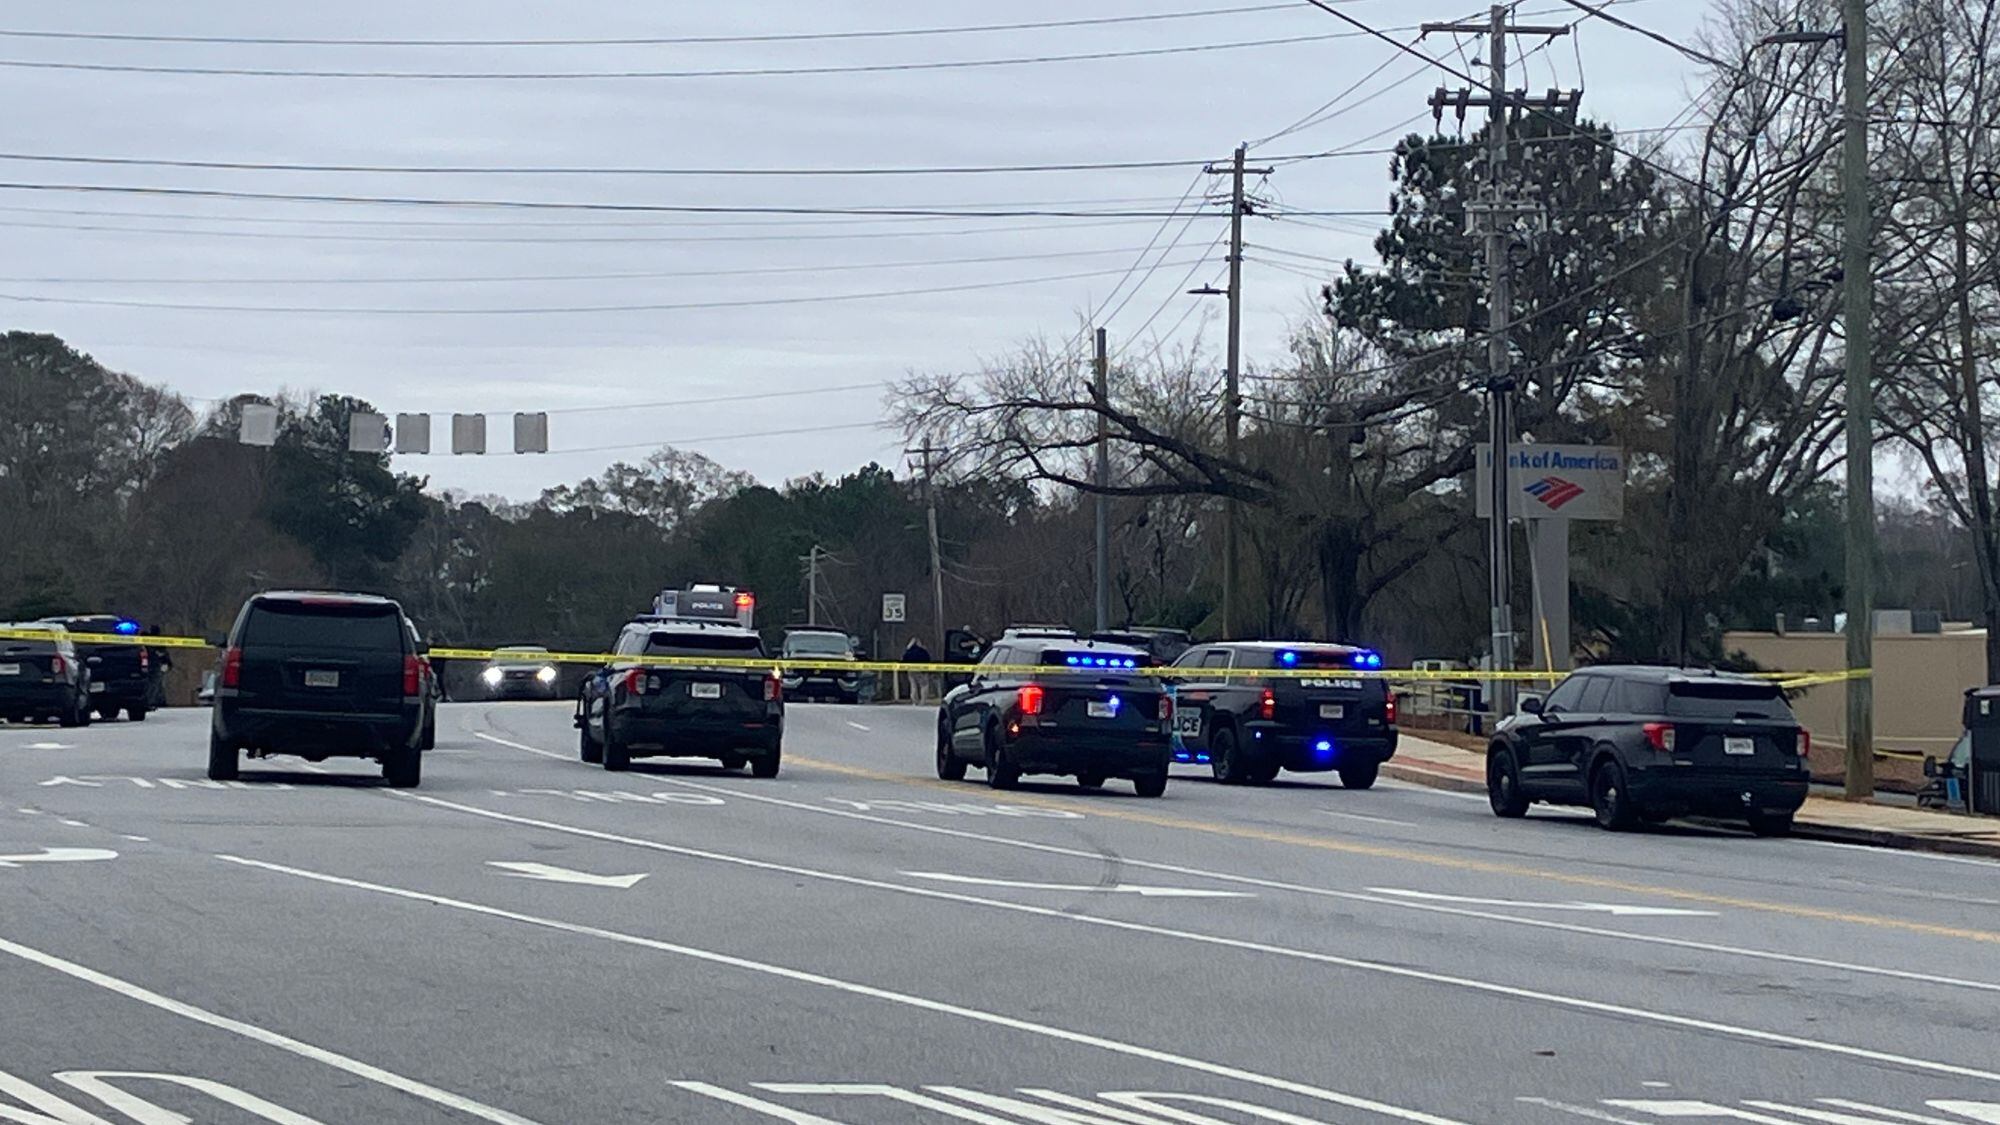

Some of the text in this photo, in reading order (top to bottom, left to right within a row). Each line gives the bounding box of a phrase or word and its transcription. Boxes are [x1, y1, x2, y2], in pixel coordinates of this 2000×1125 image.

[1486, 451, 1618, 470] nk of America
[691, 602, 724, 610] POLICE
[885, 607, 903, 618] 35
[1300, 678, 1362, 689] POLICE
